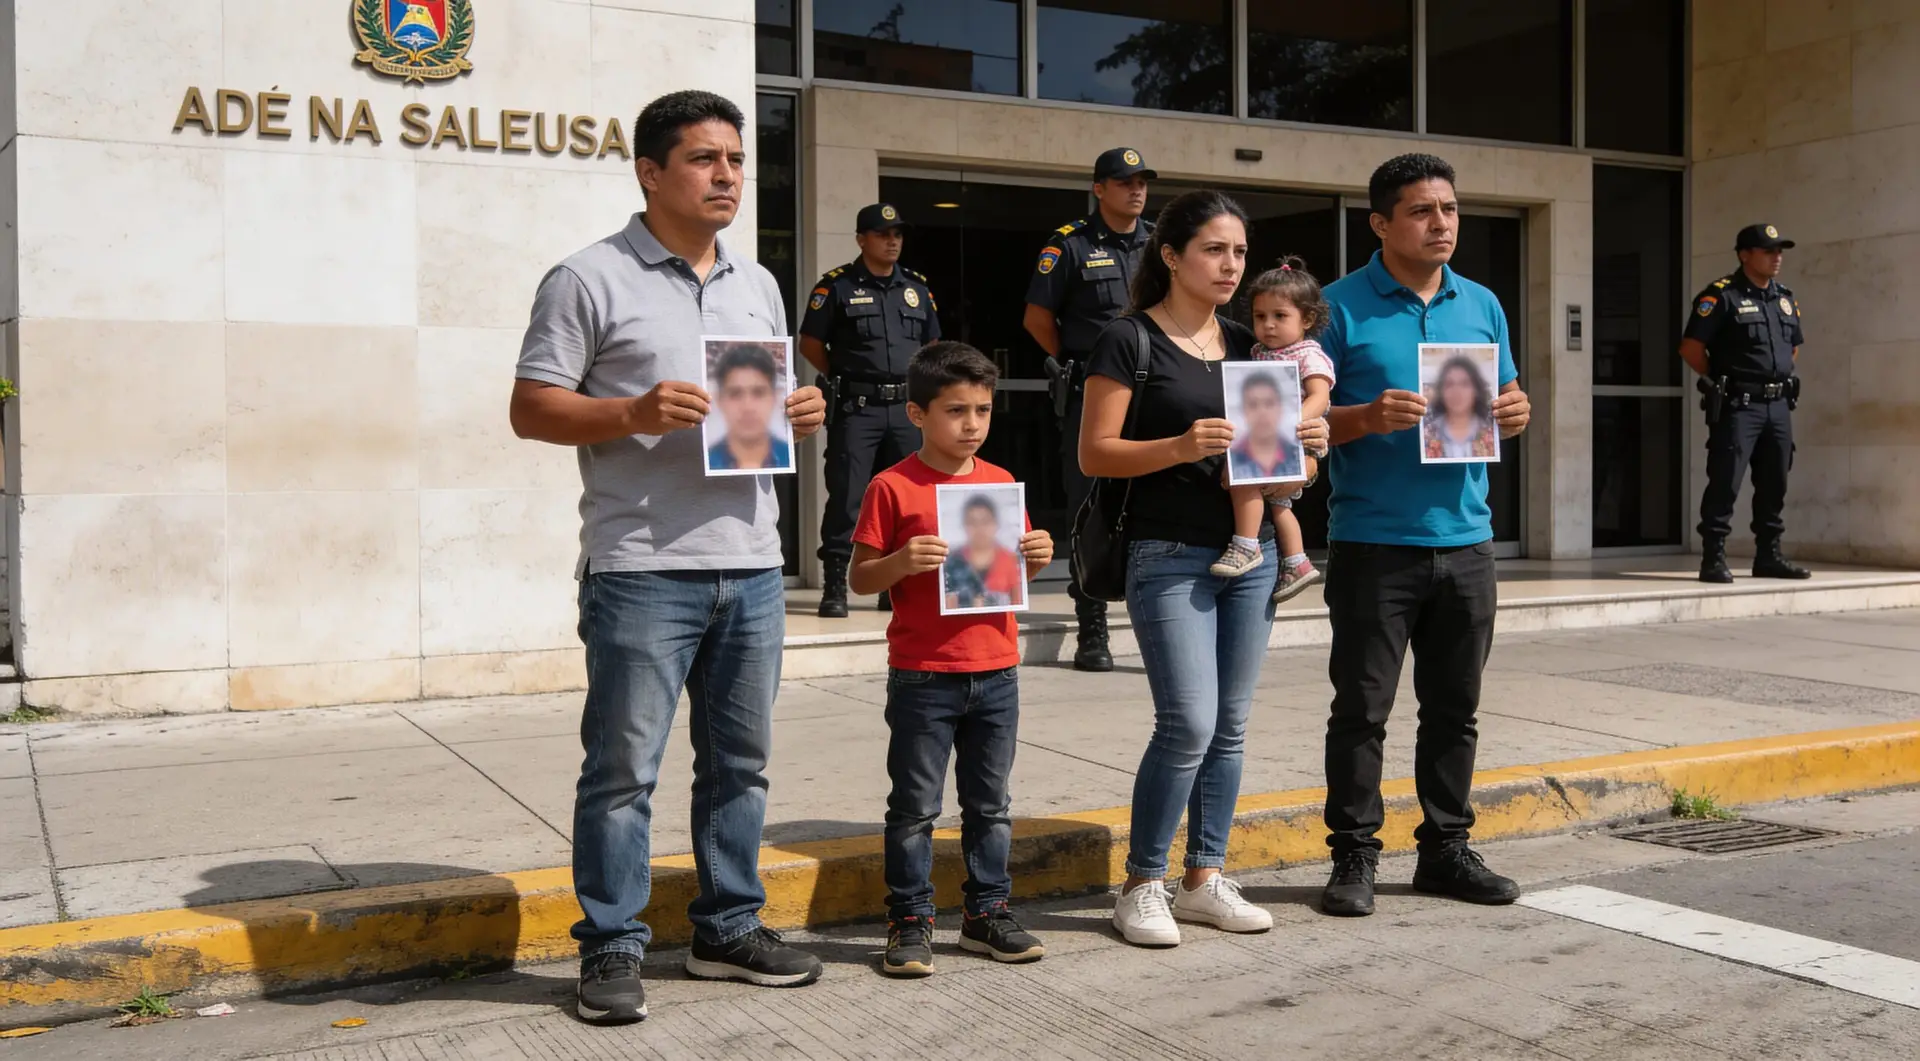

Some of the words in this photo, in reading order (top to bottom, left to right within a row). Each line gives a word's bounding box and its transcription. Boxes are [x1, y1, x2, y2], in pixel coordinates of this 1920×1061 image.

[173, 85, 292, 137] ADÉ
[310, 96, 382, 144] NA
[401, 104, 632, 159] SALEUSA
